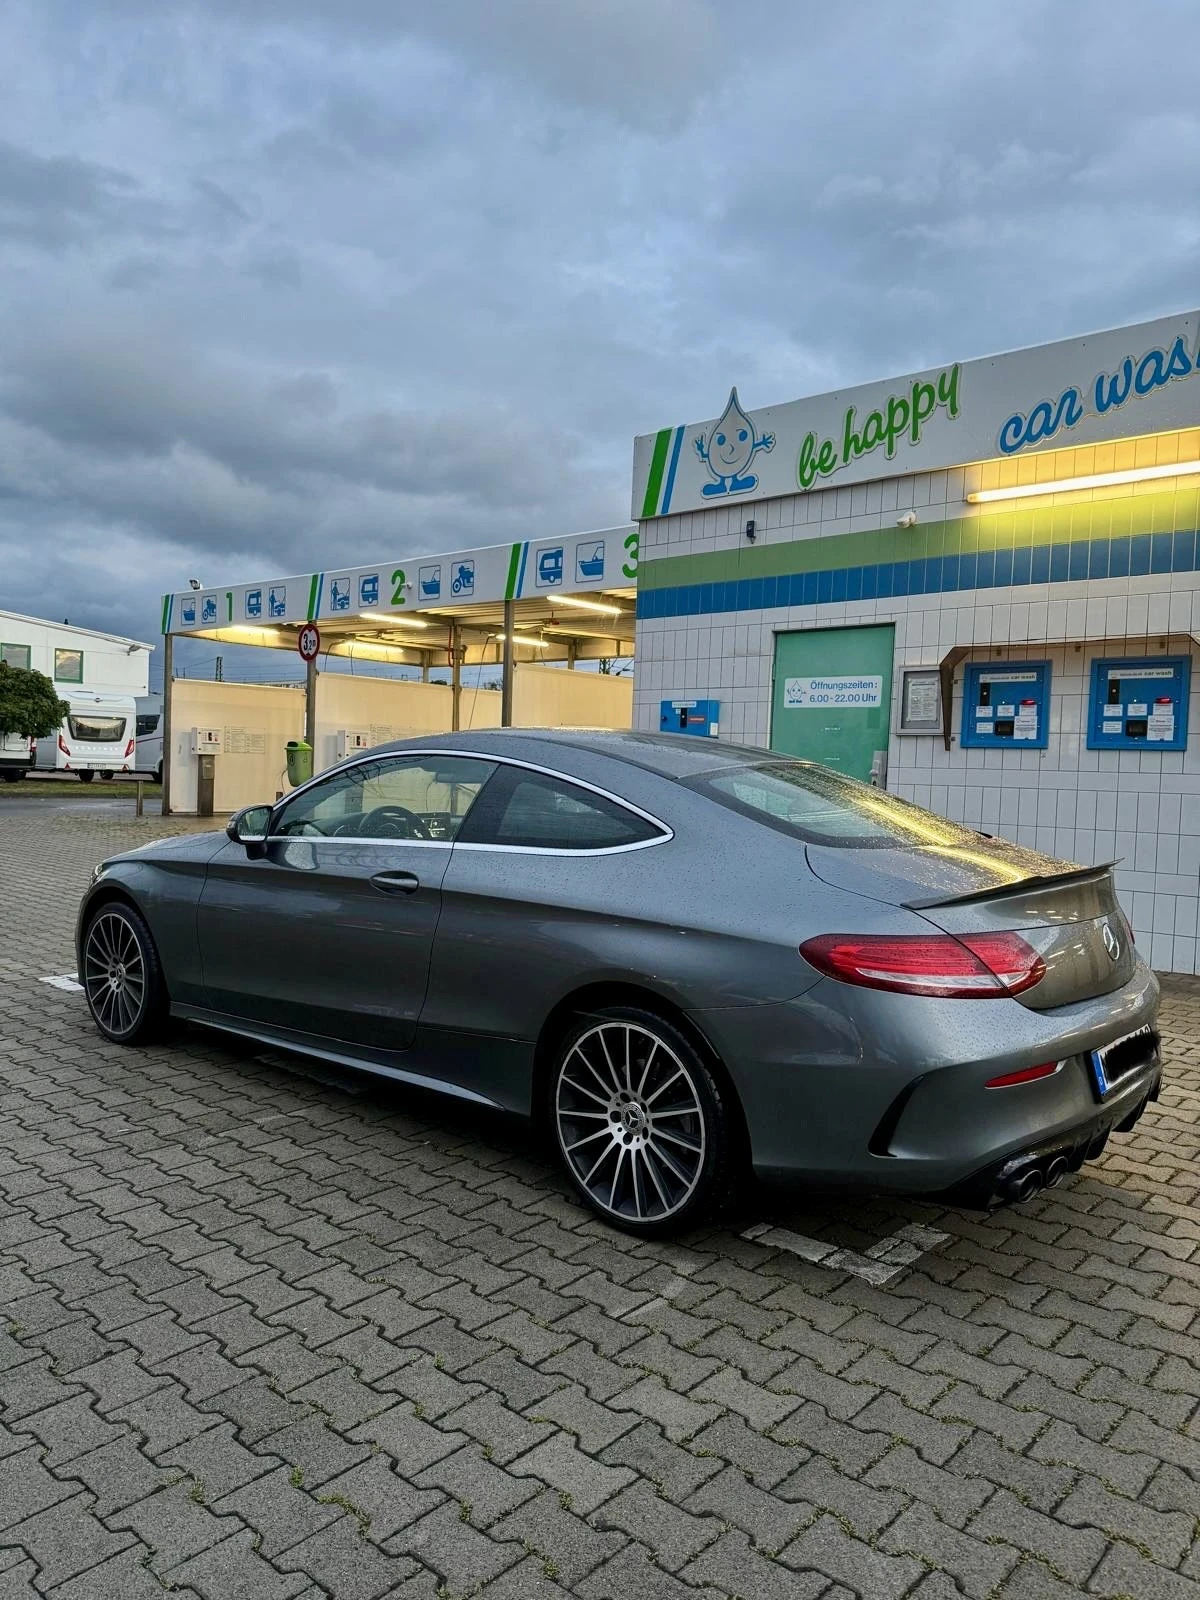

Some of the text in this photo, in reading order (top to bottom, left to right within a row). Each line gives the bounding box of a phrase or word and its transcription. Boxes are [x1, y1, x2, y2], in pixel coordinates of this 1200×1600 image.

[999, 337, 1200, 454] car was
[798, 365, 959, 488] be happy
[622, 533, 639, 579] 3
[225, 591, 233, 622] 1
[390, 569, 406, 605] 2
[861, 693, 877, 702] Uhr
